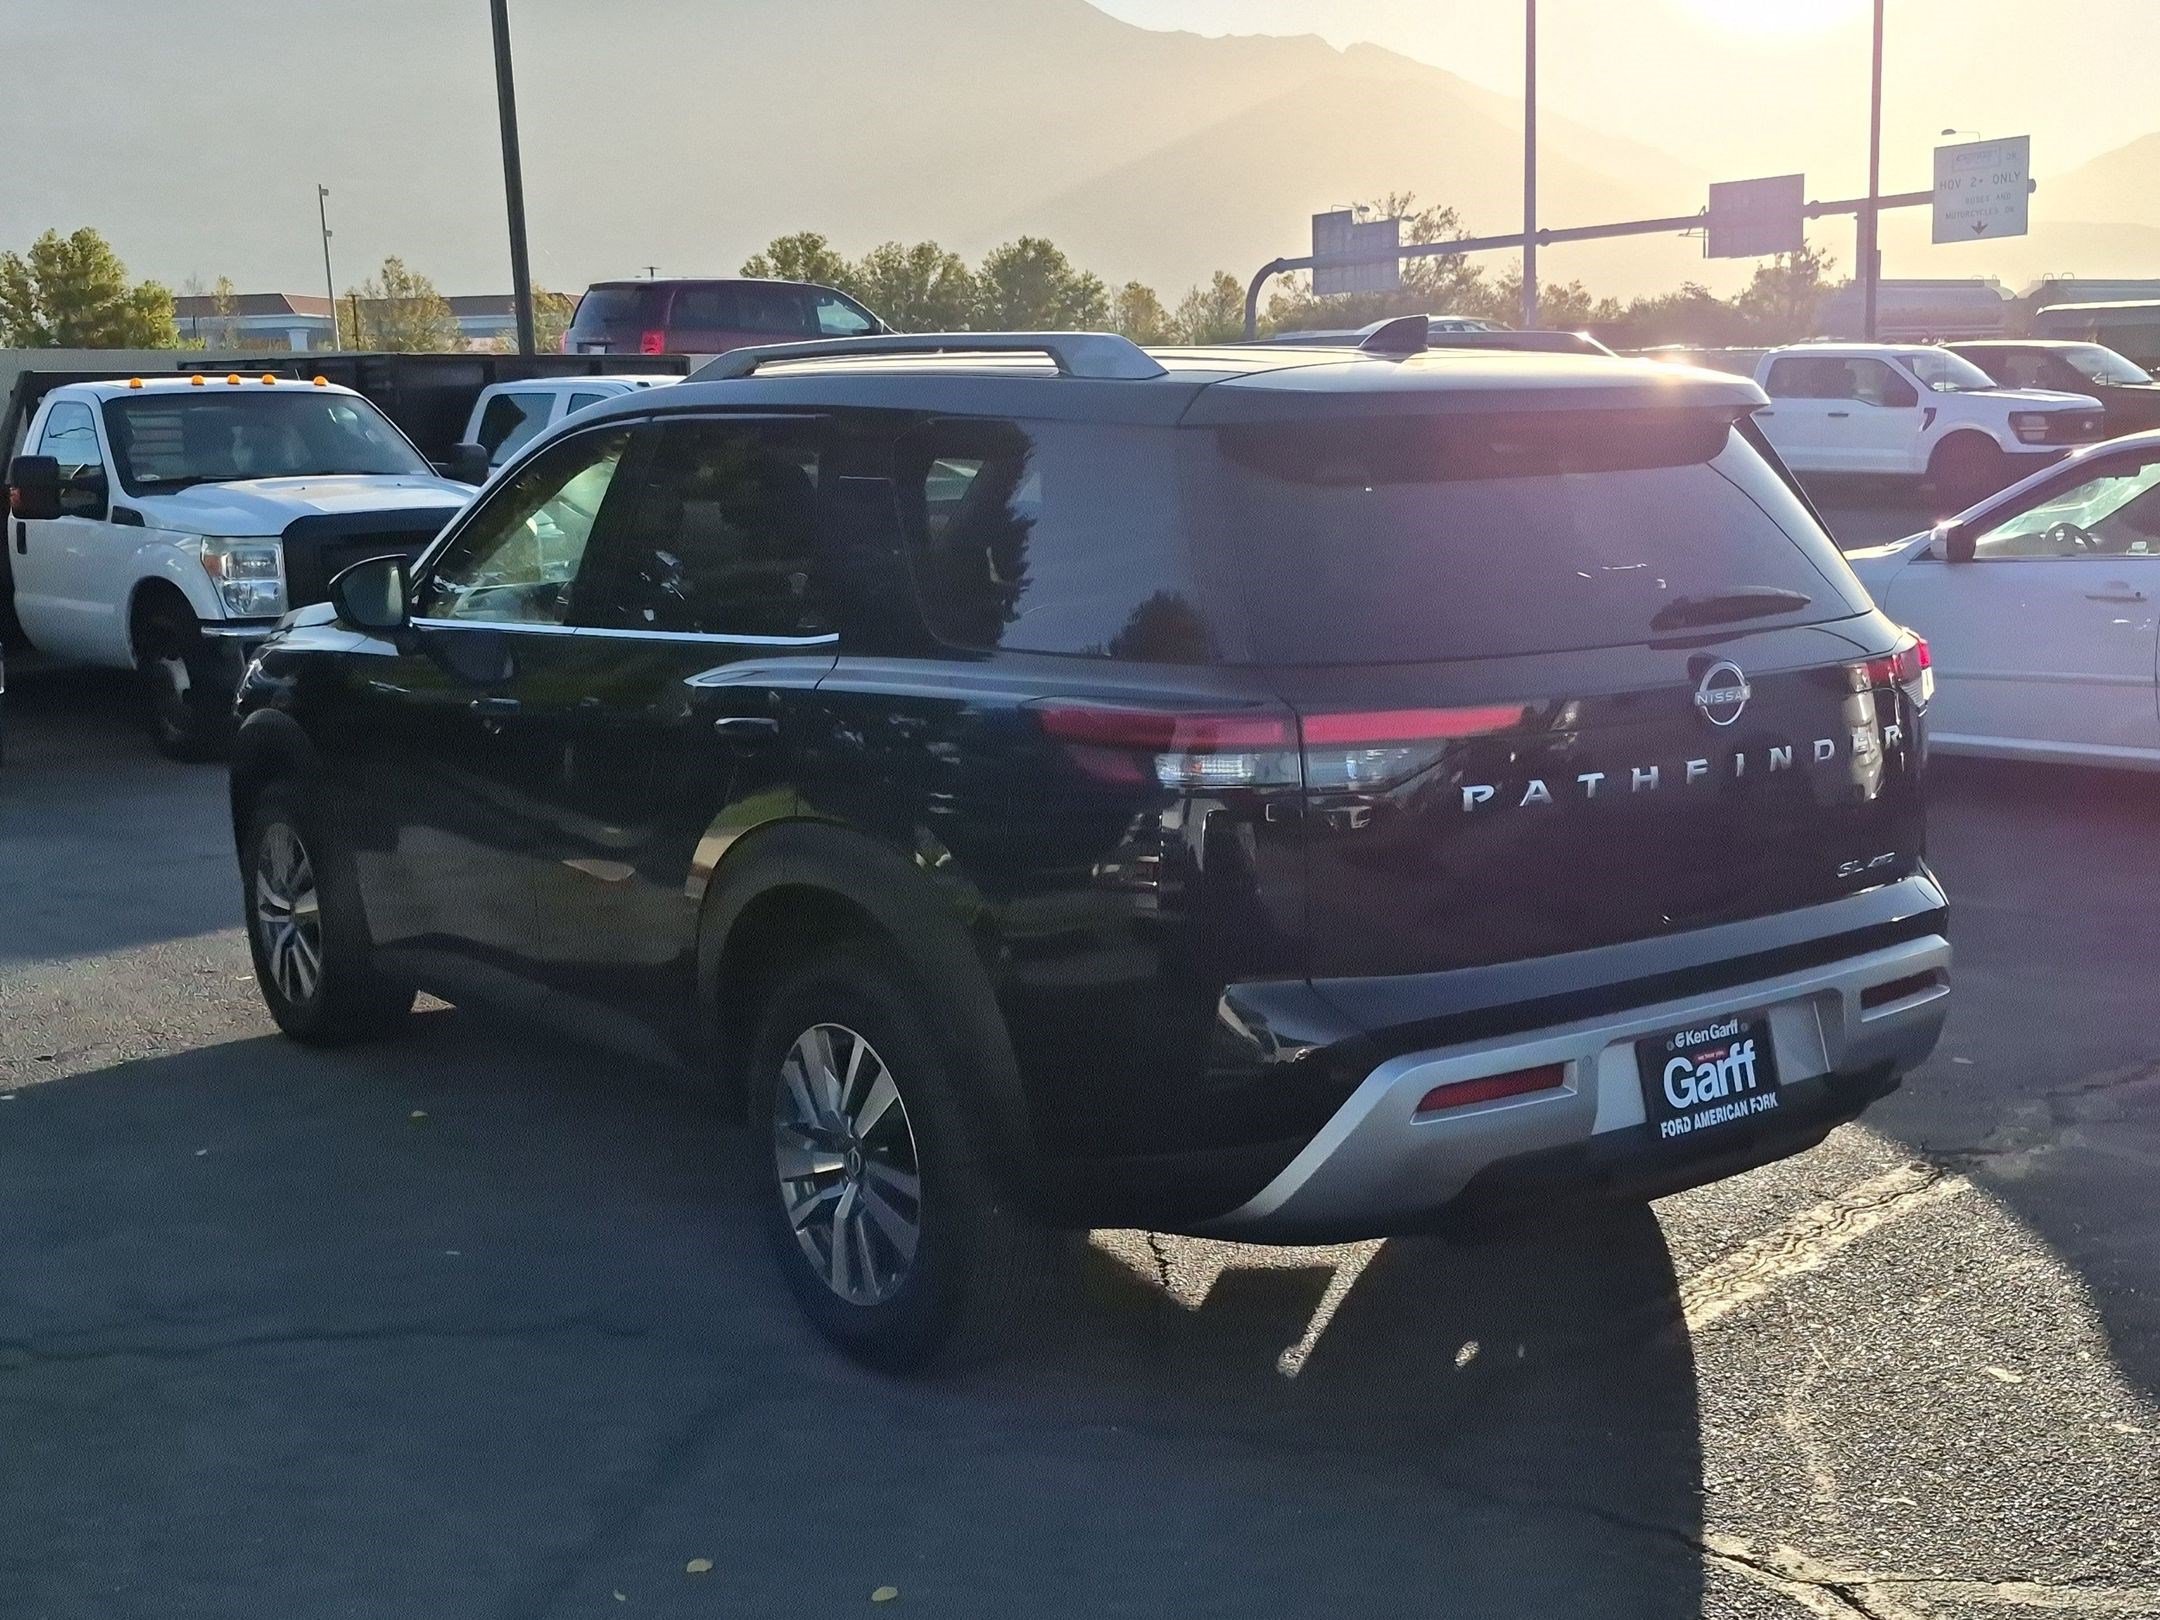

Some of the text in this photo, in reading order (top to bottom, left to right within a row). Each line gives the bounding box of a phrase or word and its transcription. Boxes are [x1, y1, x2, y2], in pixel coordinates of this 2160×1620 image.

[1940, 178, 1962, 190] HOV
[1992, 171, 2021, 184] ONLY
[1697, 688, 1748, 705] NISSA
[1460, 724, 1900, 812] PATHFINDER
[1685, 1018, 1739, 1046] Ken Garff
[1663, 1039, 1757, 1109] Garff
[1660, 1092, 1779, 1139] FORD AMERICAN FORK
